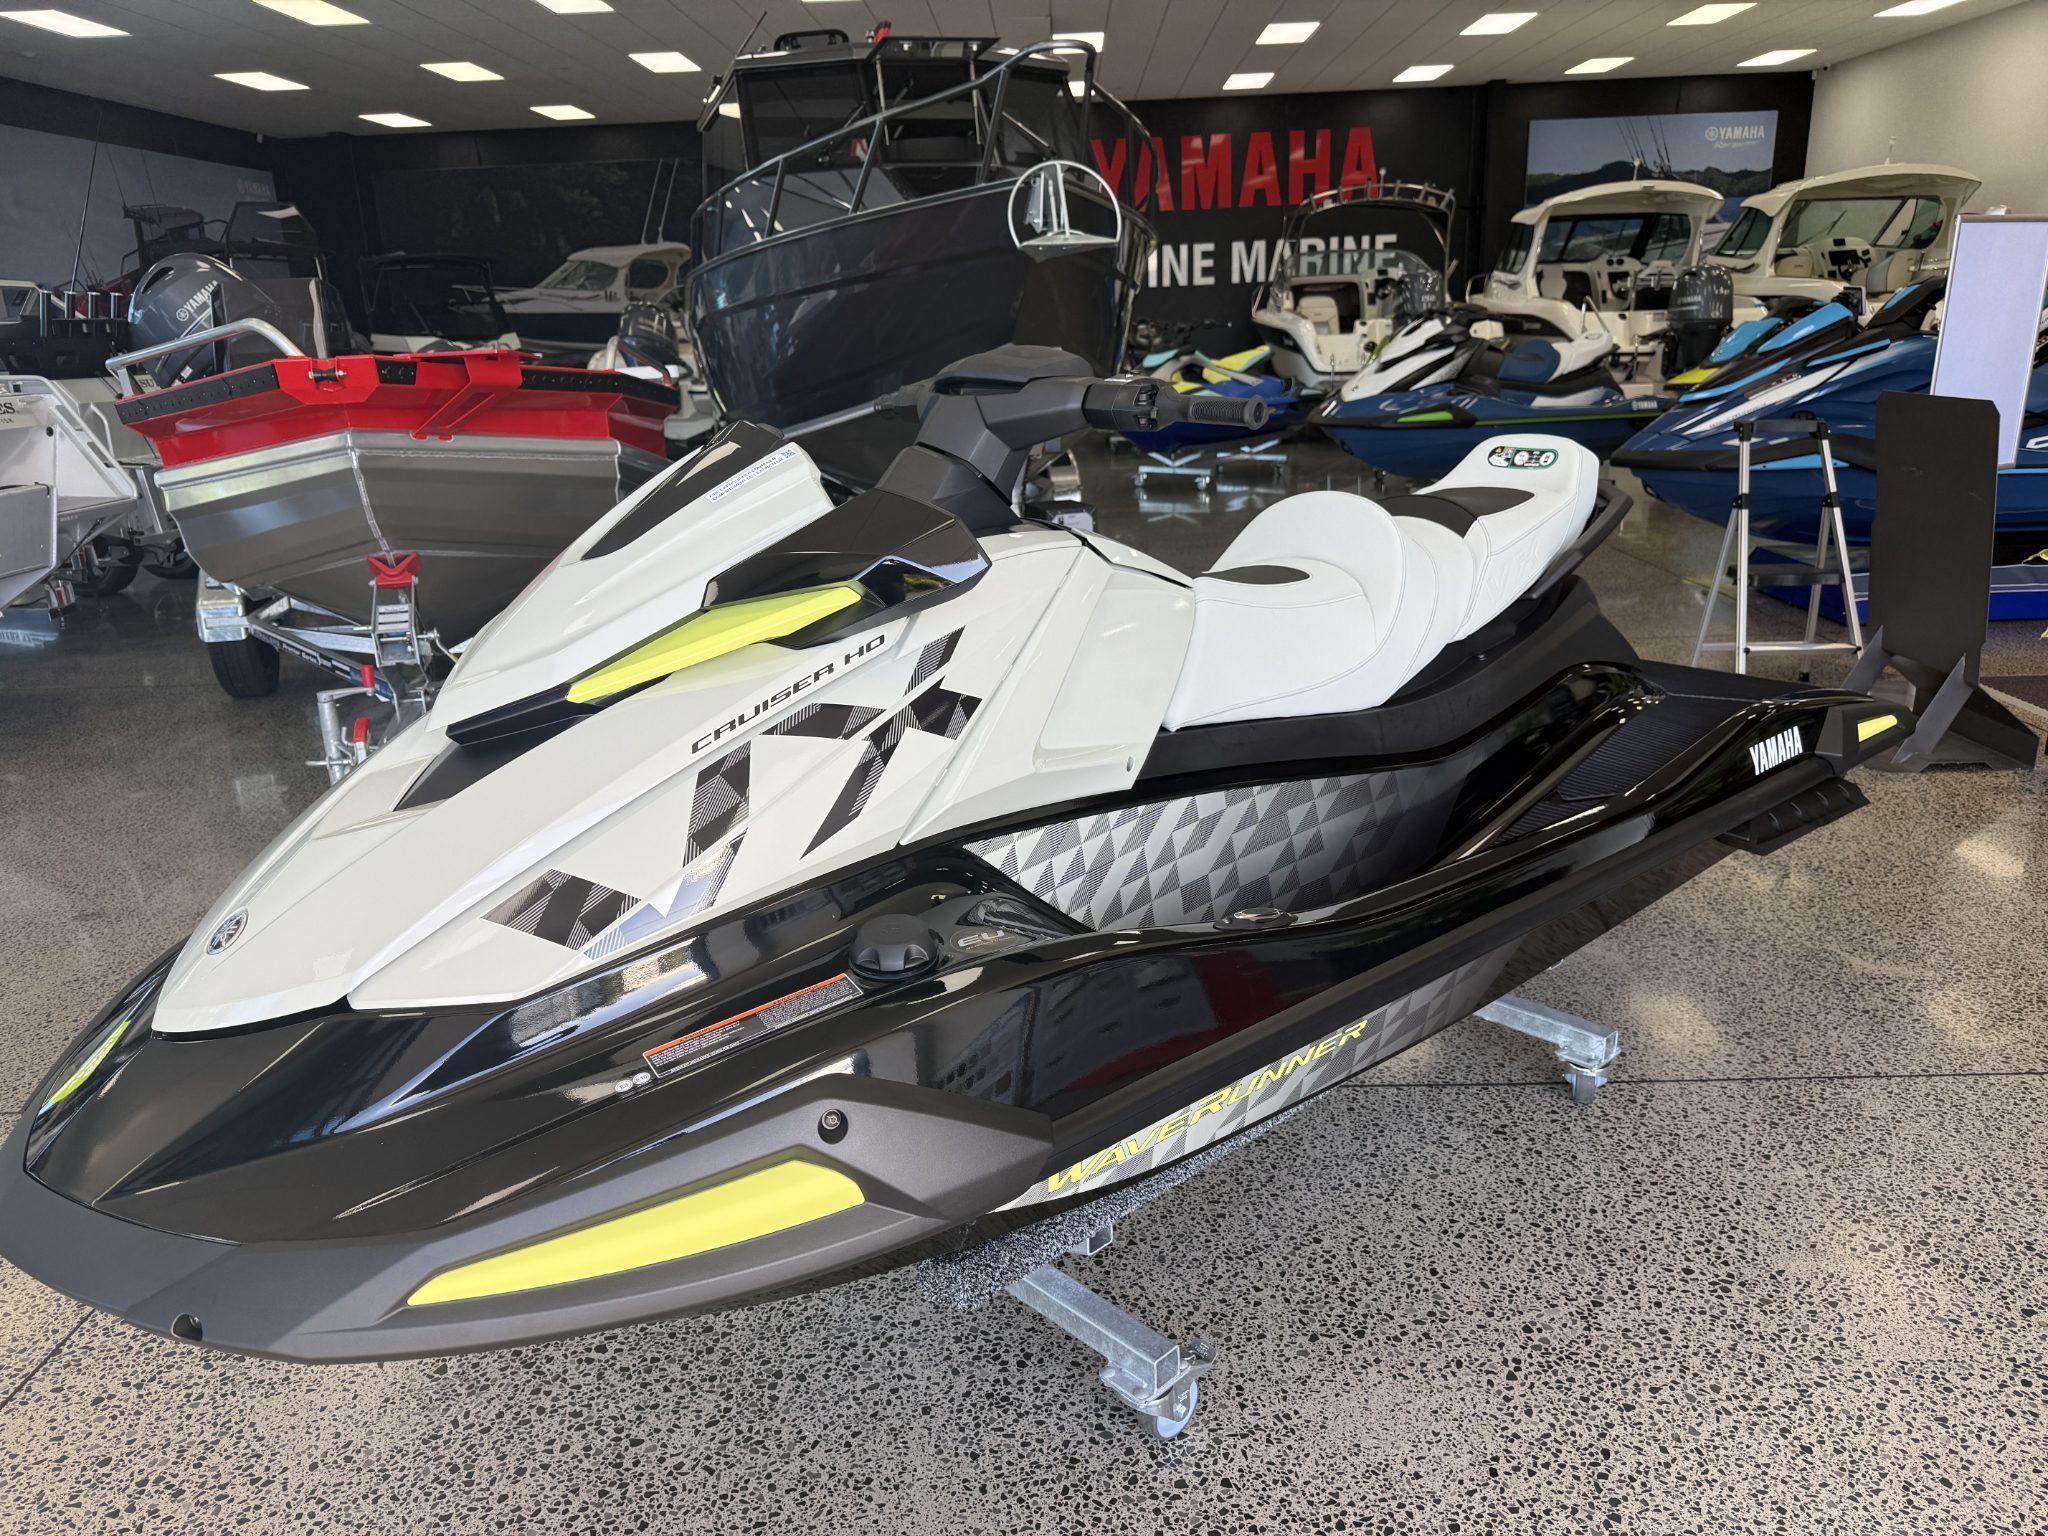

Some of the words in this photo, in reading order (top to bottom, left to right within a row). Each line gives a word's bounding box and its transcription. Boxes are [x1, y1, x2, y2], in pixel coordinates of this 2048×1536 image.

[1719, 125, 1765, 140] YAMAHA
[1090, 127, 1379, 213] YAMAHA
[1231, 234, 1398, 284] MARINE
[691, 663, 834, 754] CRUISER
[844, 634, 885, 666] HO
[1749, 725, 1803, 776] YAMAHA
[1047, 1019, 1368, 1193] WAVERUNNER
